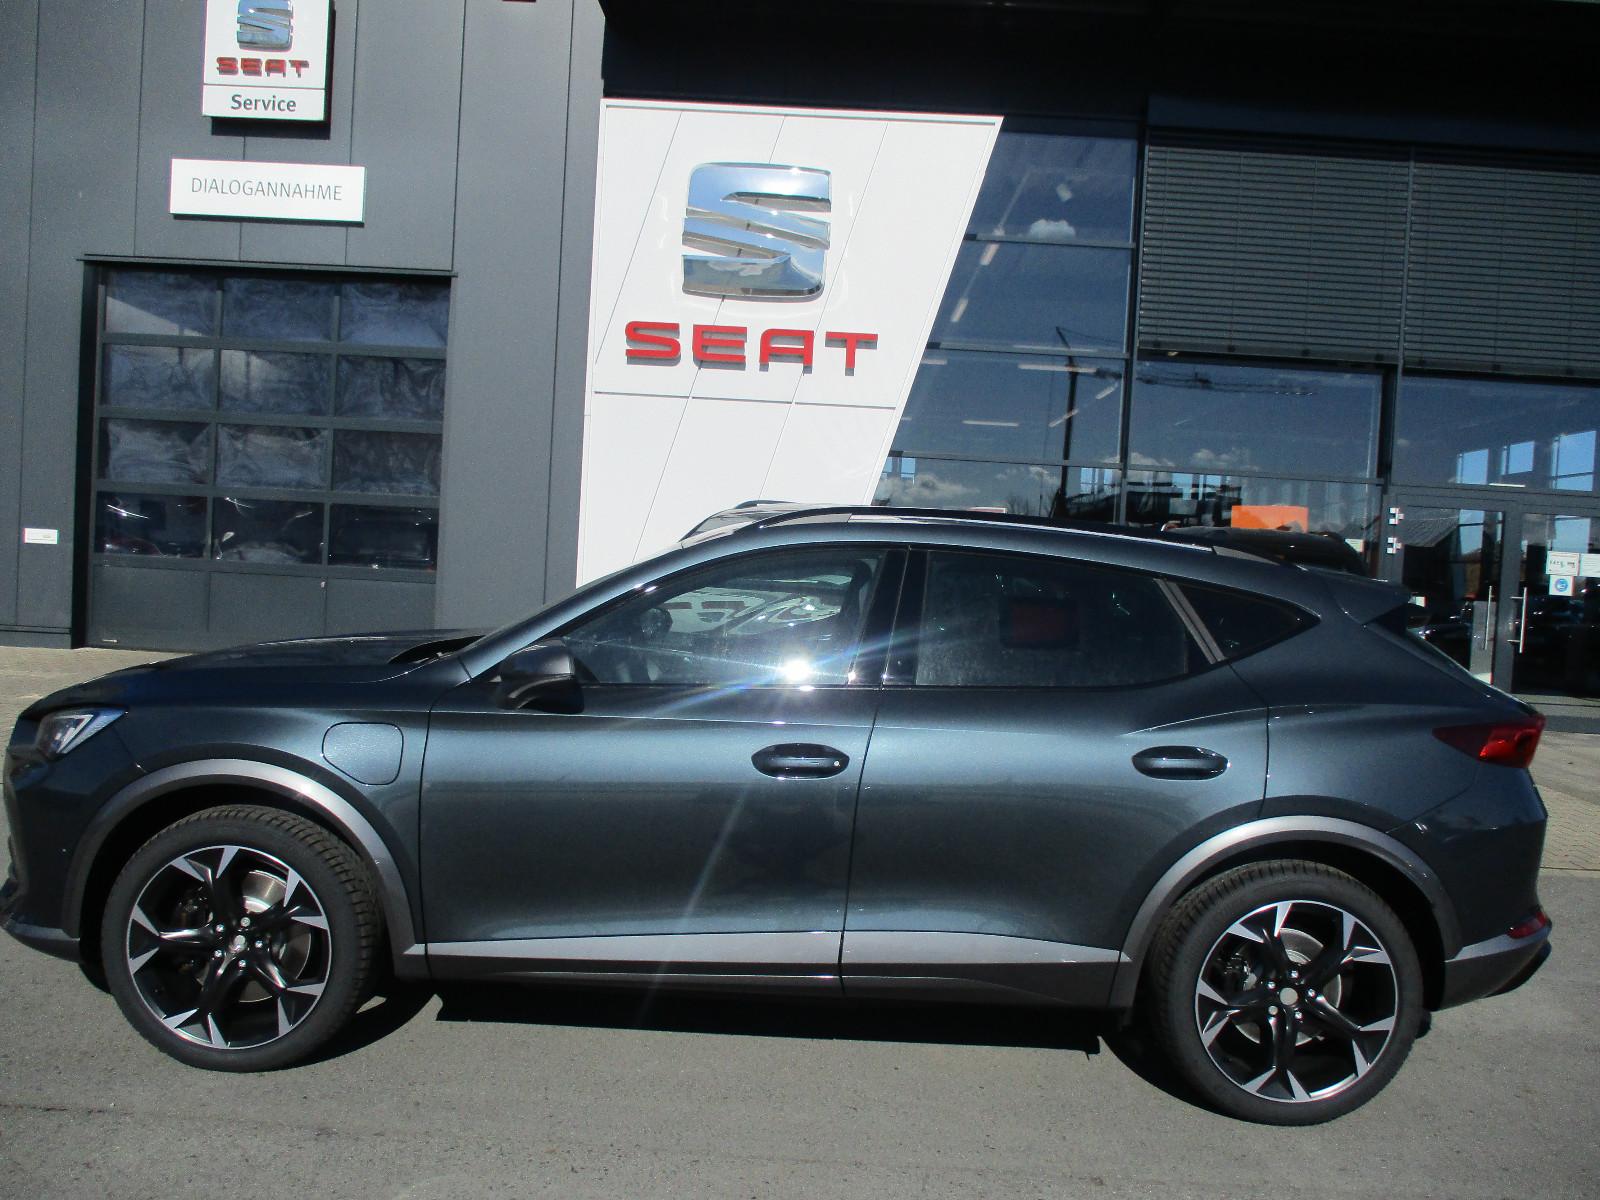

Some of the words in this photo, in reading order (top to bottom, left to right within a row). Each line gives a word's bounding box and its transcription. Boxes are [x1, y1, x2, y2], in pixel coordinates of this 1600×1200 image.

[216, 57, 310, 78] SEAT
[230, 94, 297, 112] Service
[191, 177, 343, 201] DIALOGANNAHME
[625, 321, 878, 371] SEAT
